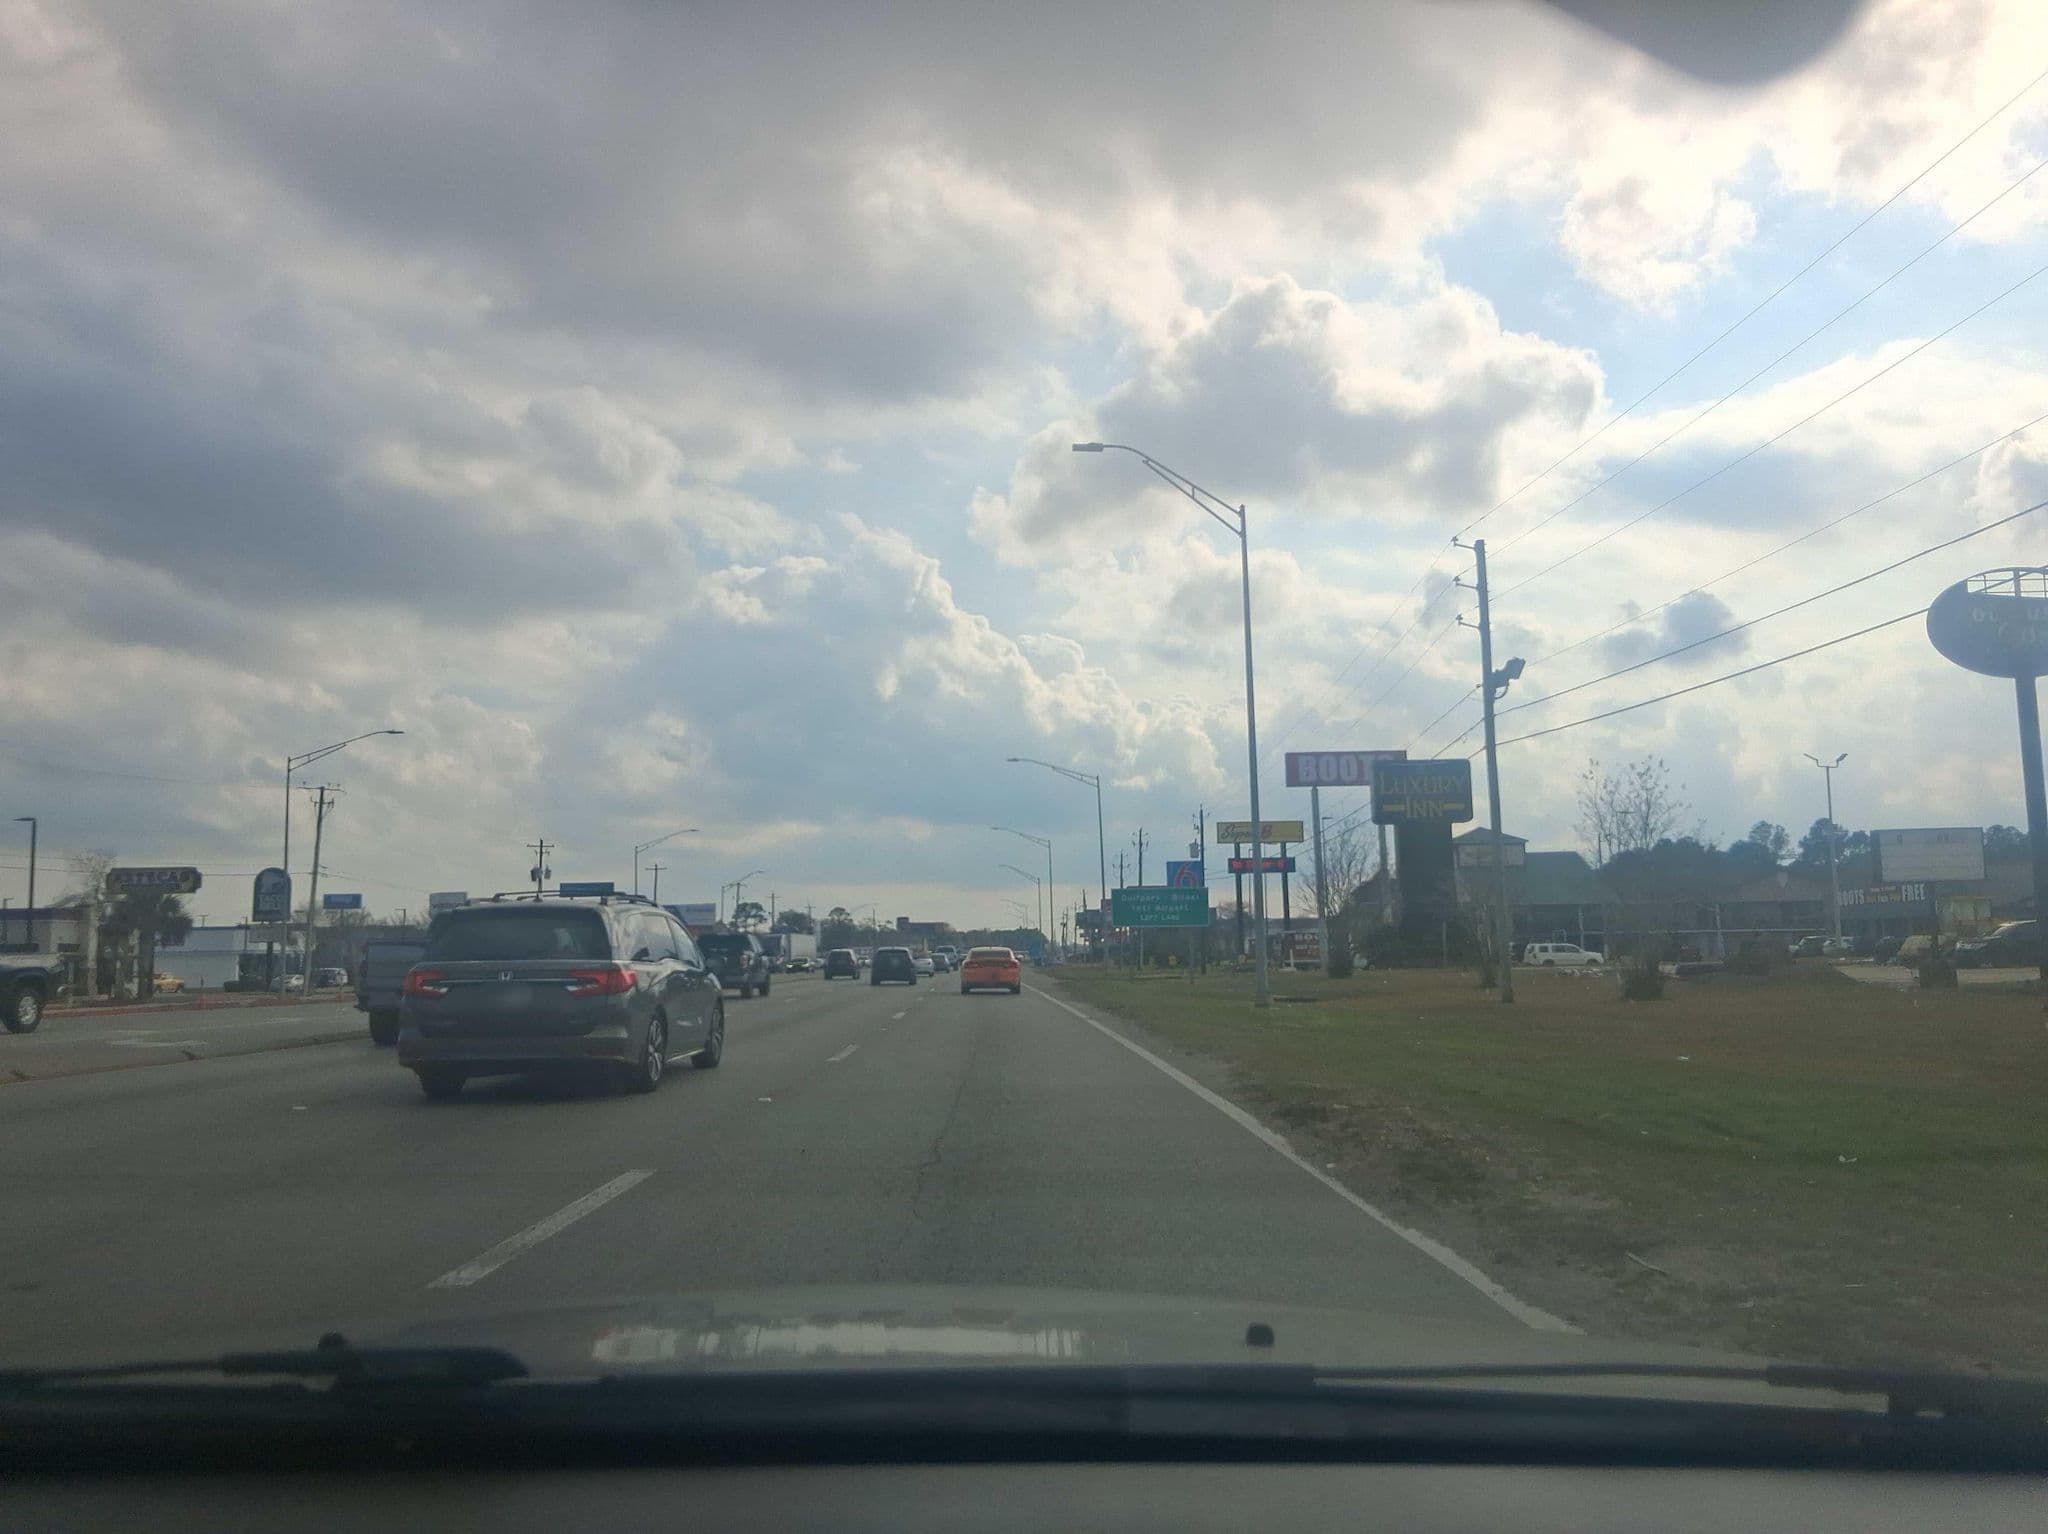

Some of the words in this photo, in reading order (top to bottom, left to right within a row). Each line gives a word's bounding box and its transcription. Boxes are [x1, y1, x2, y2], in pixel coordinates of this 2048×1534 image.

[1298, 752, 1394, 783] BOOT
[1379, 771, 1466, 795] LUXURY
[1405, 795, 1444, 818] INN
